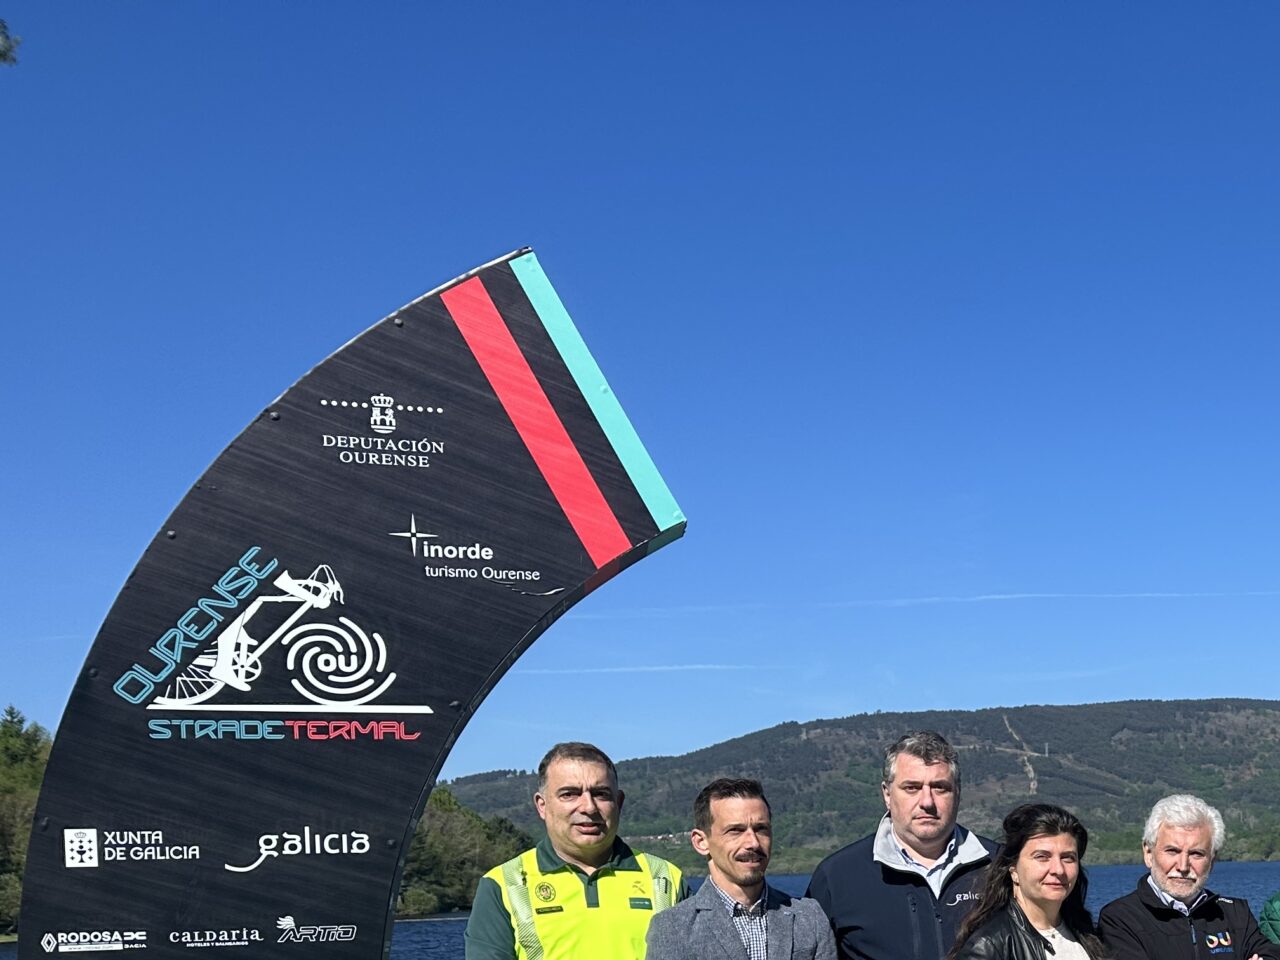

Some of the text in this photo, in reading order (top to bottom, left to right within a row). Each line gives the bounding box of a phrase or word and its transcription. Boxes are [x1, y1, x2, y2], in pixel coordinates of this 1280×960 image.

[322, 434, 445, 454] DEPUTACIÓN
[339, 450, 430, 468] OURENSE
[424, 541, 493, 559] inorde
[424, 565, 541, 582] turismo Ourense
[112, 546, 279, 705] OURENSE
[317, 651, 358, 673] OU
[104, 831, 162, 844] XUNTA
[104, 844, 200, 861] DE GALICIA
[225, 826, 370, 872] galicia
[57, 931, 122, 943] RODOSA
[1206, 931, 1232, 948] OU
